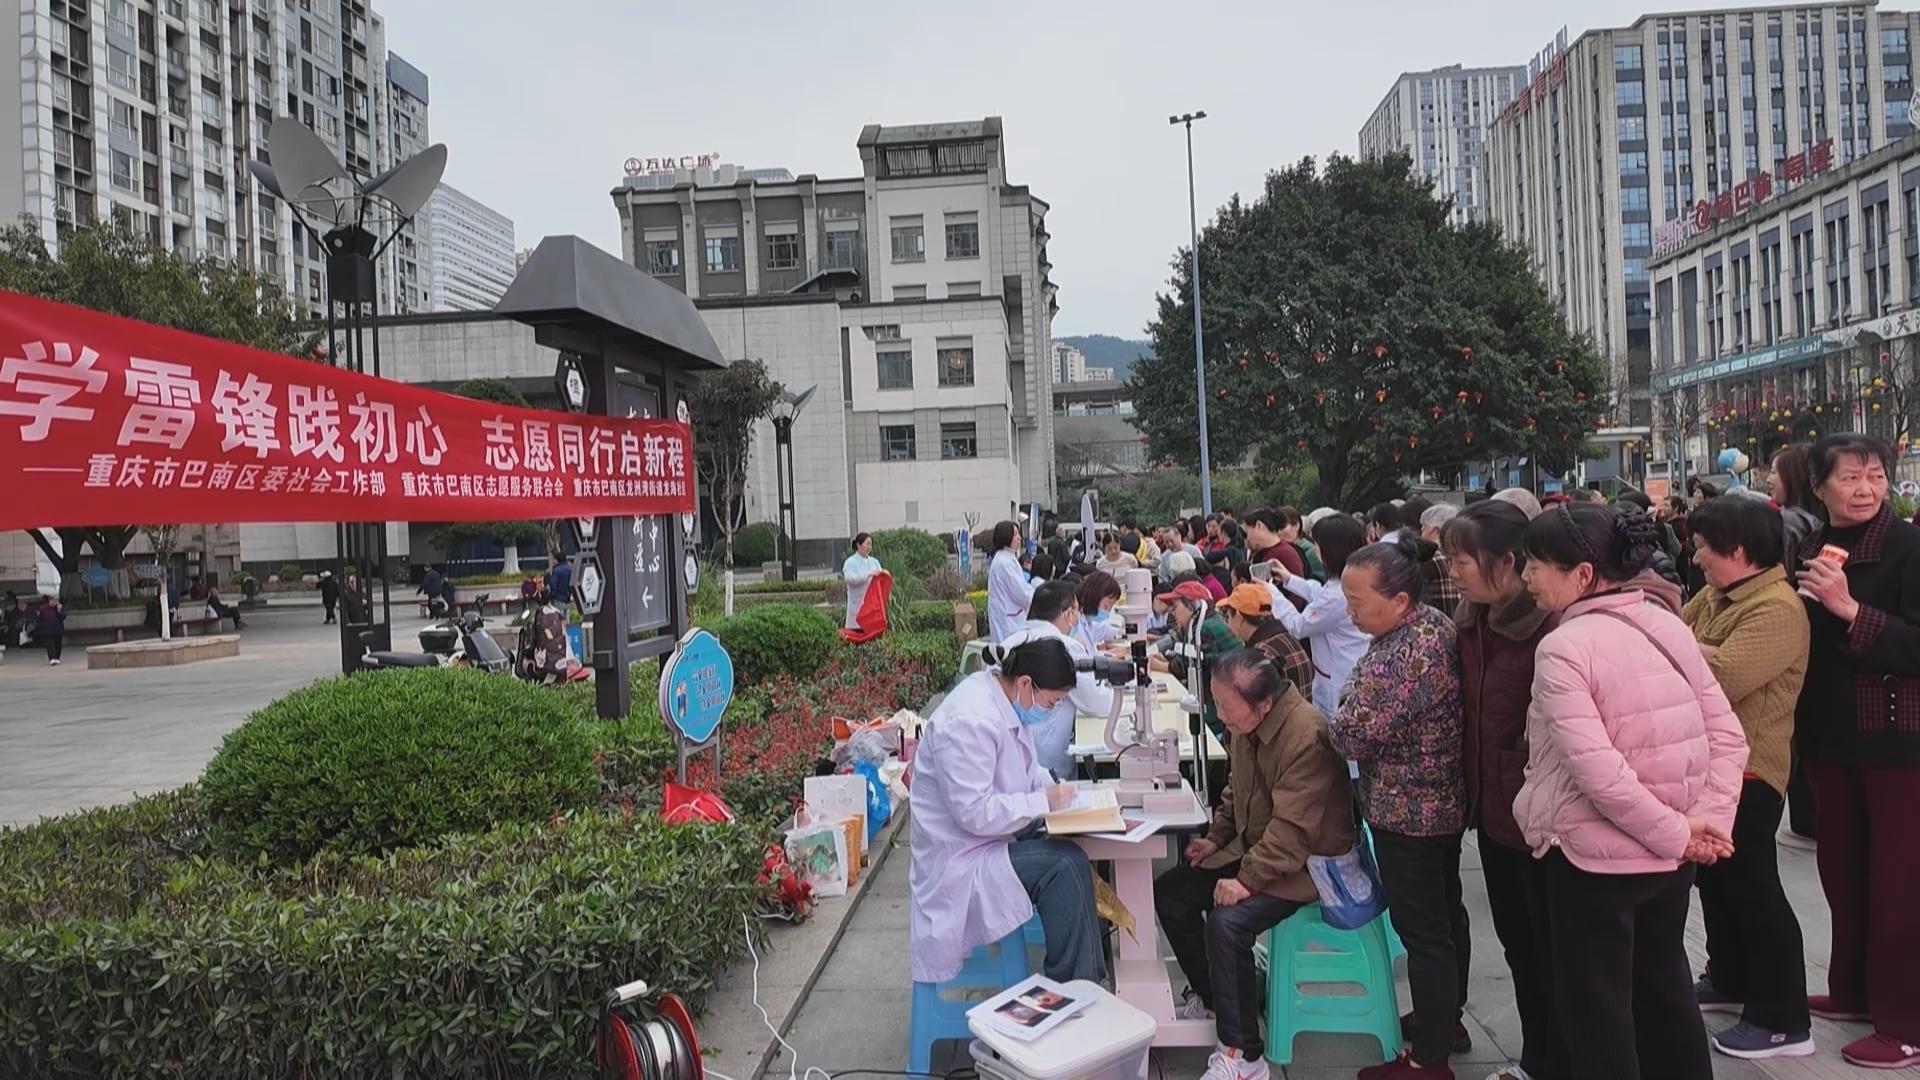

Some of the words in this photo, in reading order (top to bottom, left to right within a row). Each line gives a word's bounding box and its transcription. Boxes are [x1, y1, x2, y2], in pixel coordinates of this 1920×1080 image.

[646, 155, 712, 169] 万达广场
[0, 341, 448, 466] 学雷锋践初心
[481, 413, 685, 478] 志愿同行启新程
[401, 470, 564, 497] 重庆市巴南区志愿服务联合会
